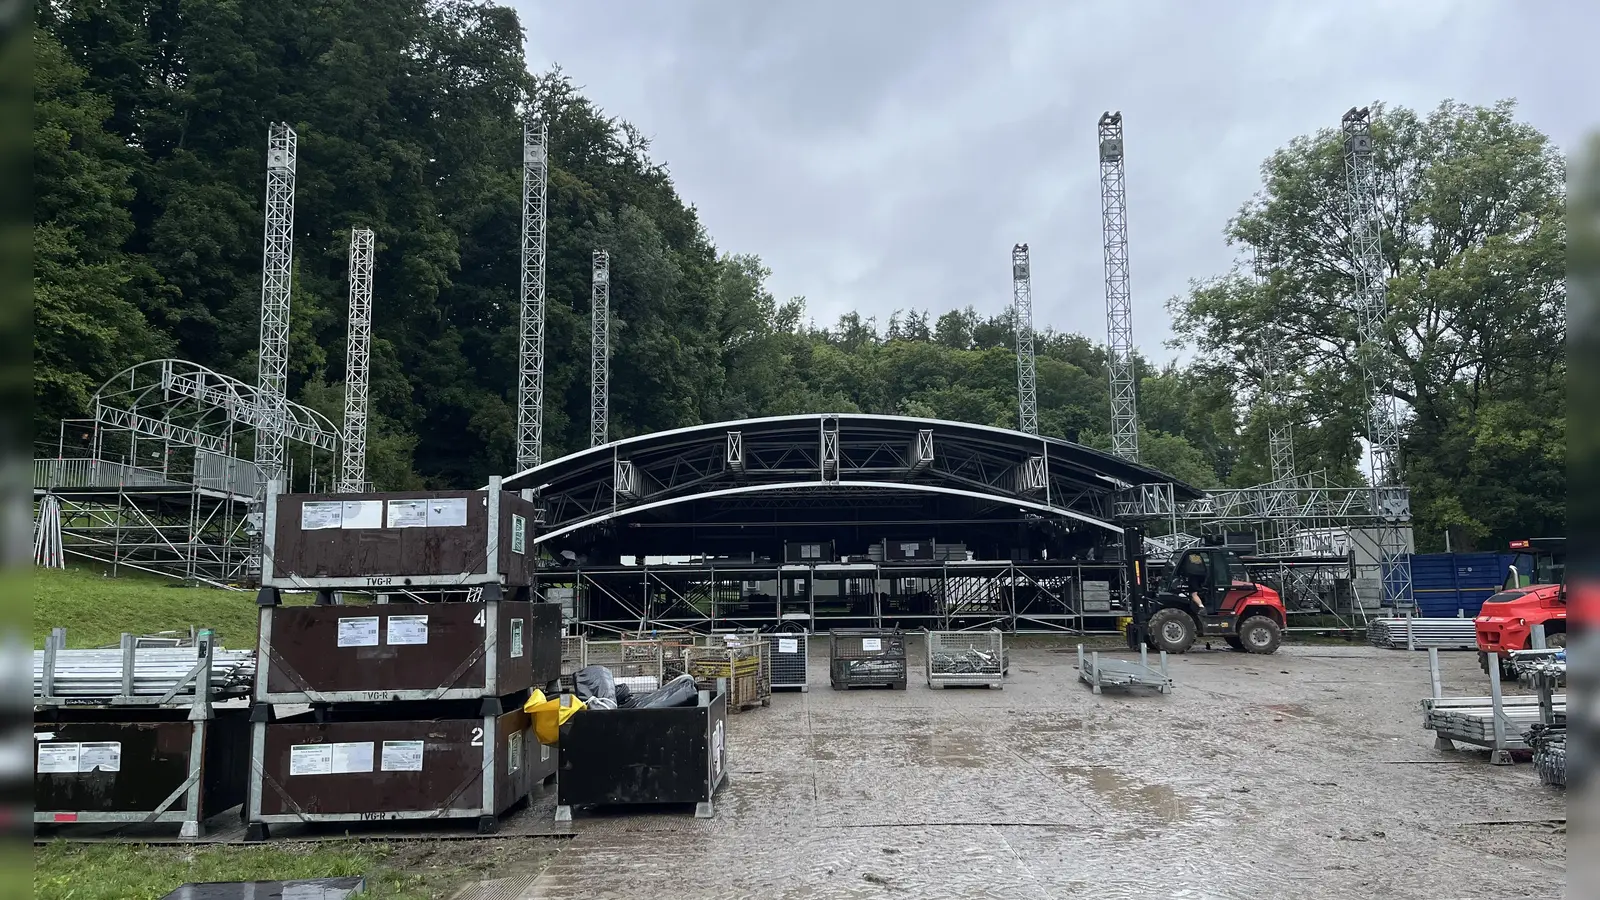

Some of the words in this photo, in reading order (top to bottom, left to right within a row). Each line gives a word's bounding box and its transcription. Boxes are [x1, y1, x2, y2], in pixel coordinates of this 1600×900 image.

[366, 578, 392, 586] TVG-R
[473, 609, 486, 627] 4
[362, 691, 388, 700] TVG-R
[471, 727, 484, 746] 2
